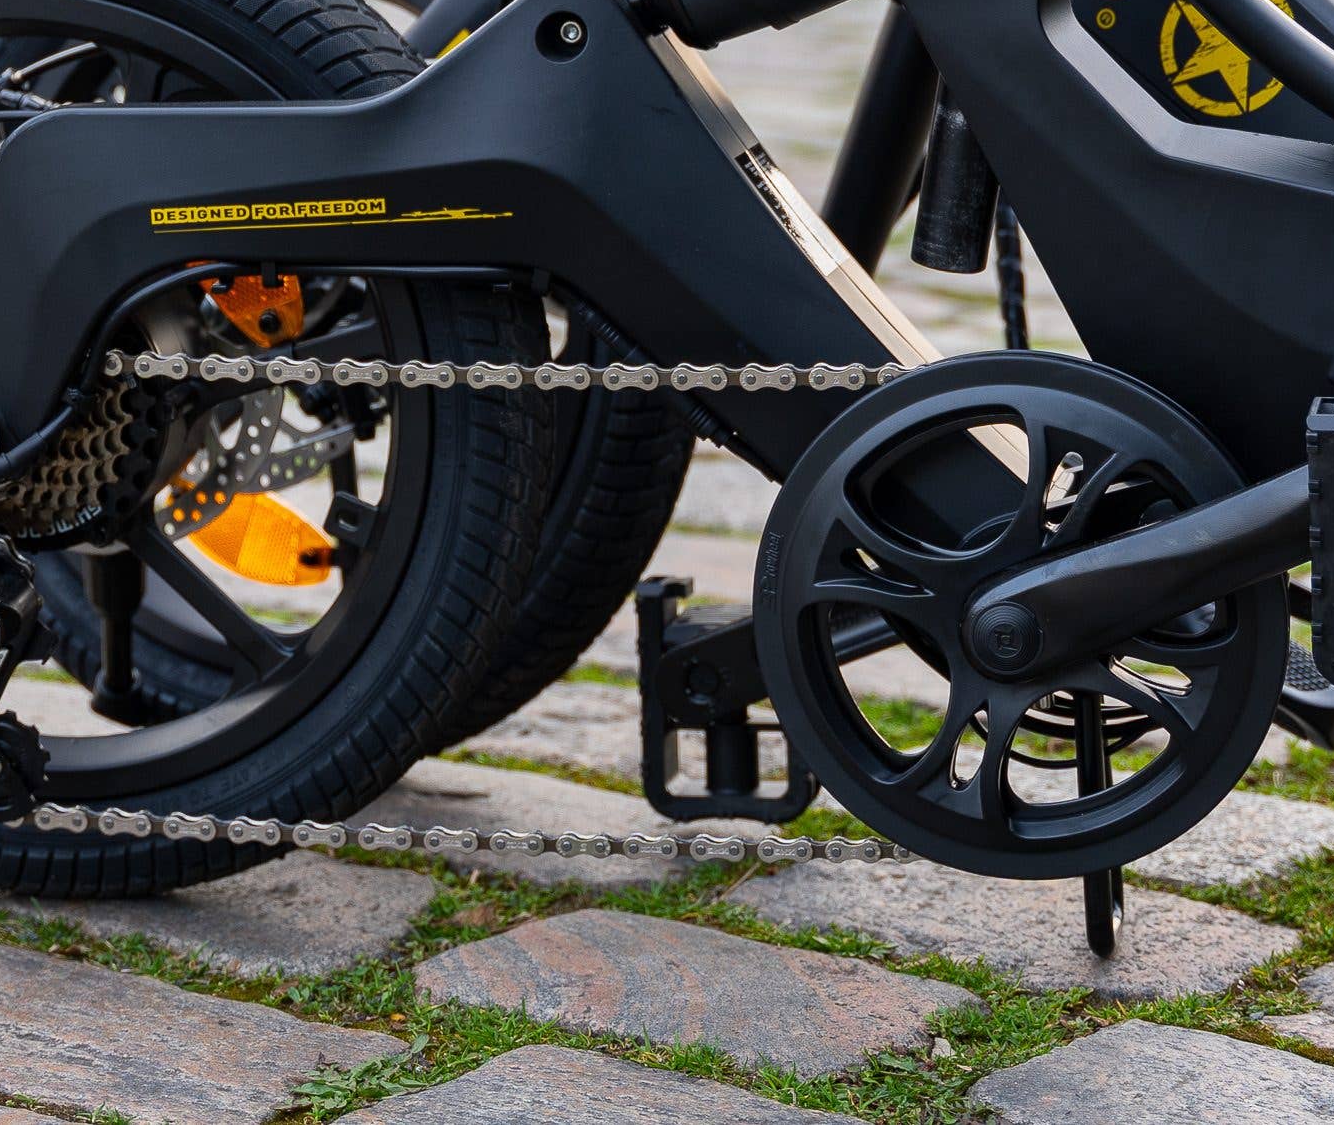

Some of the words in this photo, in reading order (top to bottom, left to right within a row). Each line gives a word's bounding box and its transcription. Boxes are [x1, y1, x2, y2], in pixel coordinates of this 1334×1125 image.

[153, 207, 248, 223] DESIGNED
[254, 205, 291, 218] FOR
[295, 199, 384, 217] FREEDOM
